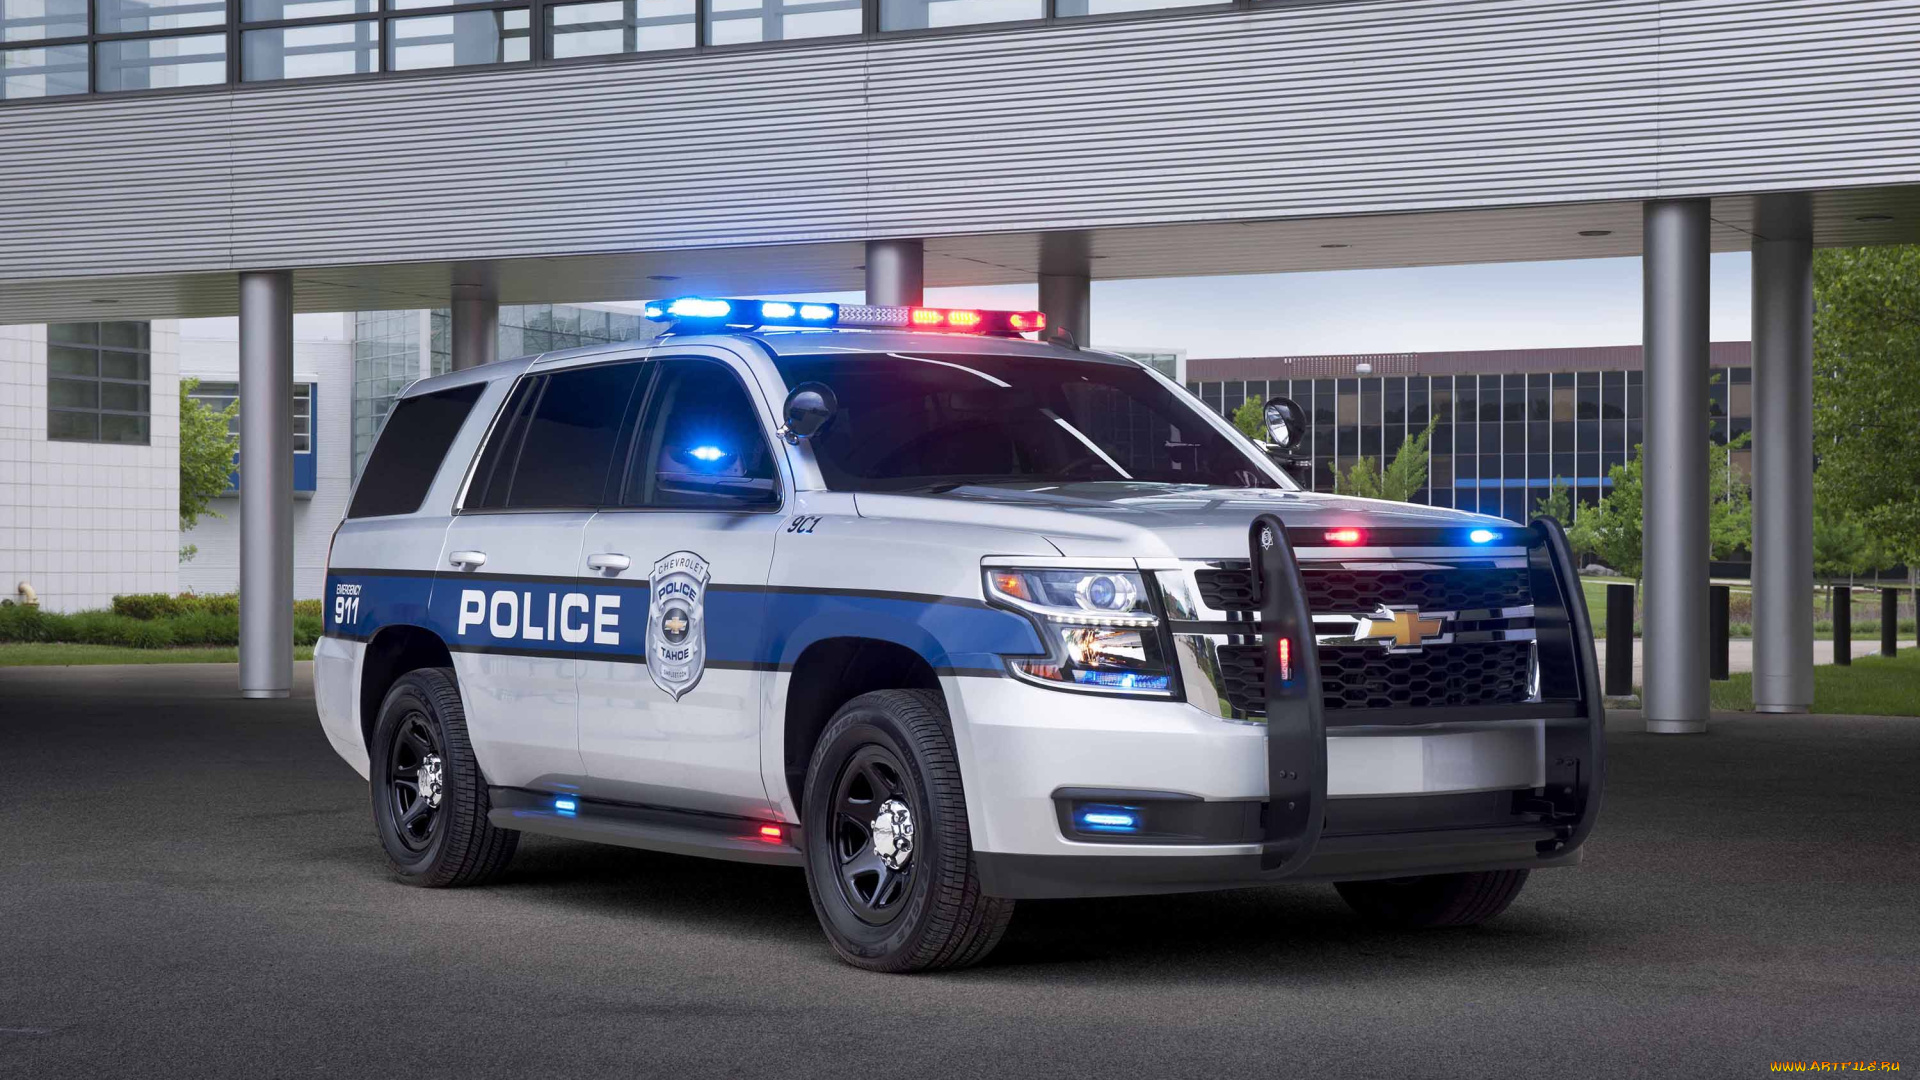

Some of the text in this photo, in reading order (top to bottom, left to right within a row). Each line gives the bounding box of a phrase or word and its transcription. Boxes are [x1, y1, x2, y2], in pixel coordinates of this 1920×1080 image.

[787, 515, 824, 534] 9C1
[658, 557, 704, 575] CHEVROLET
[658, 581, 697, 602] POLICE
[335, 596, 360, 625] 911
[458, 589, 621, 645] POLICE
[661, 647, 689, 661] TAHOE
